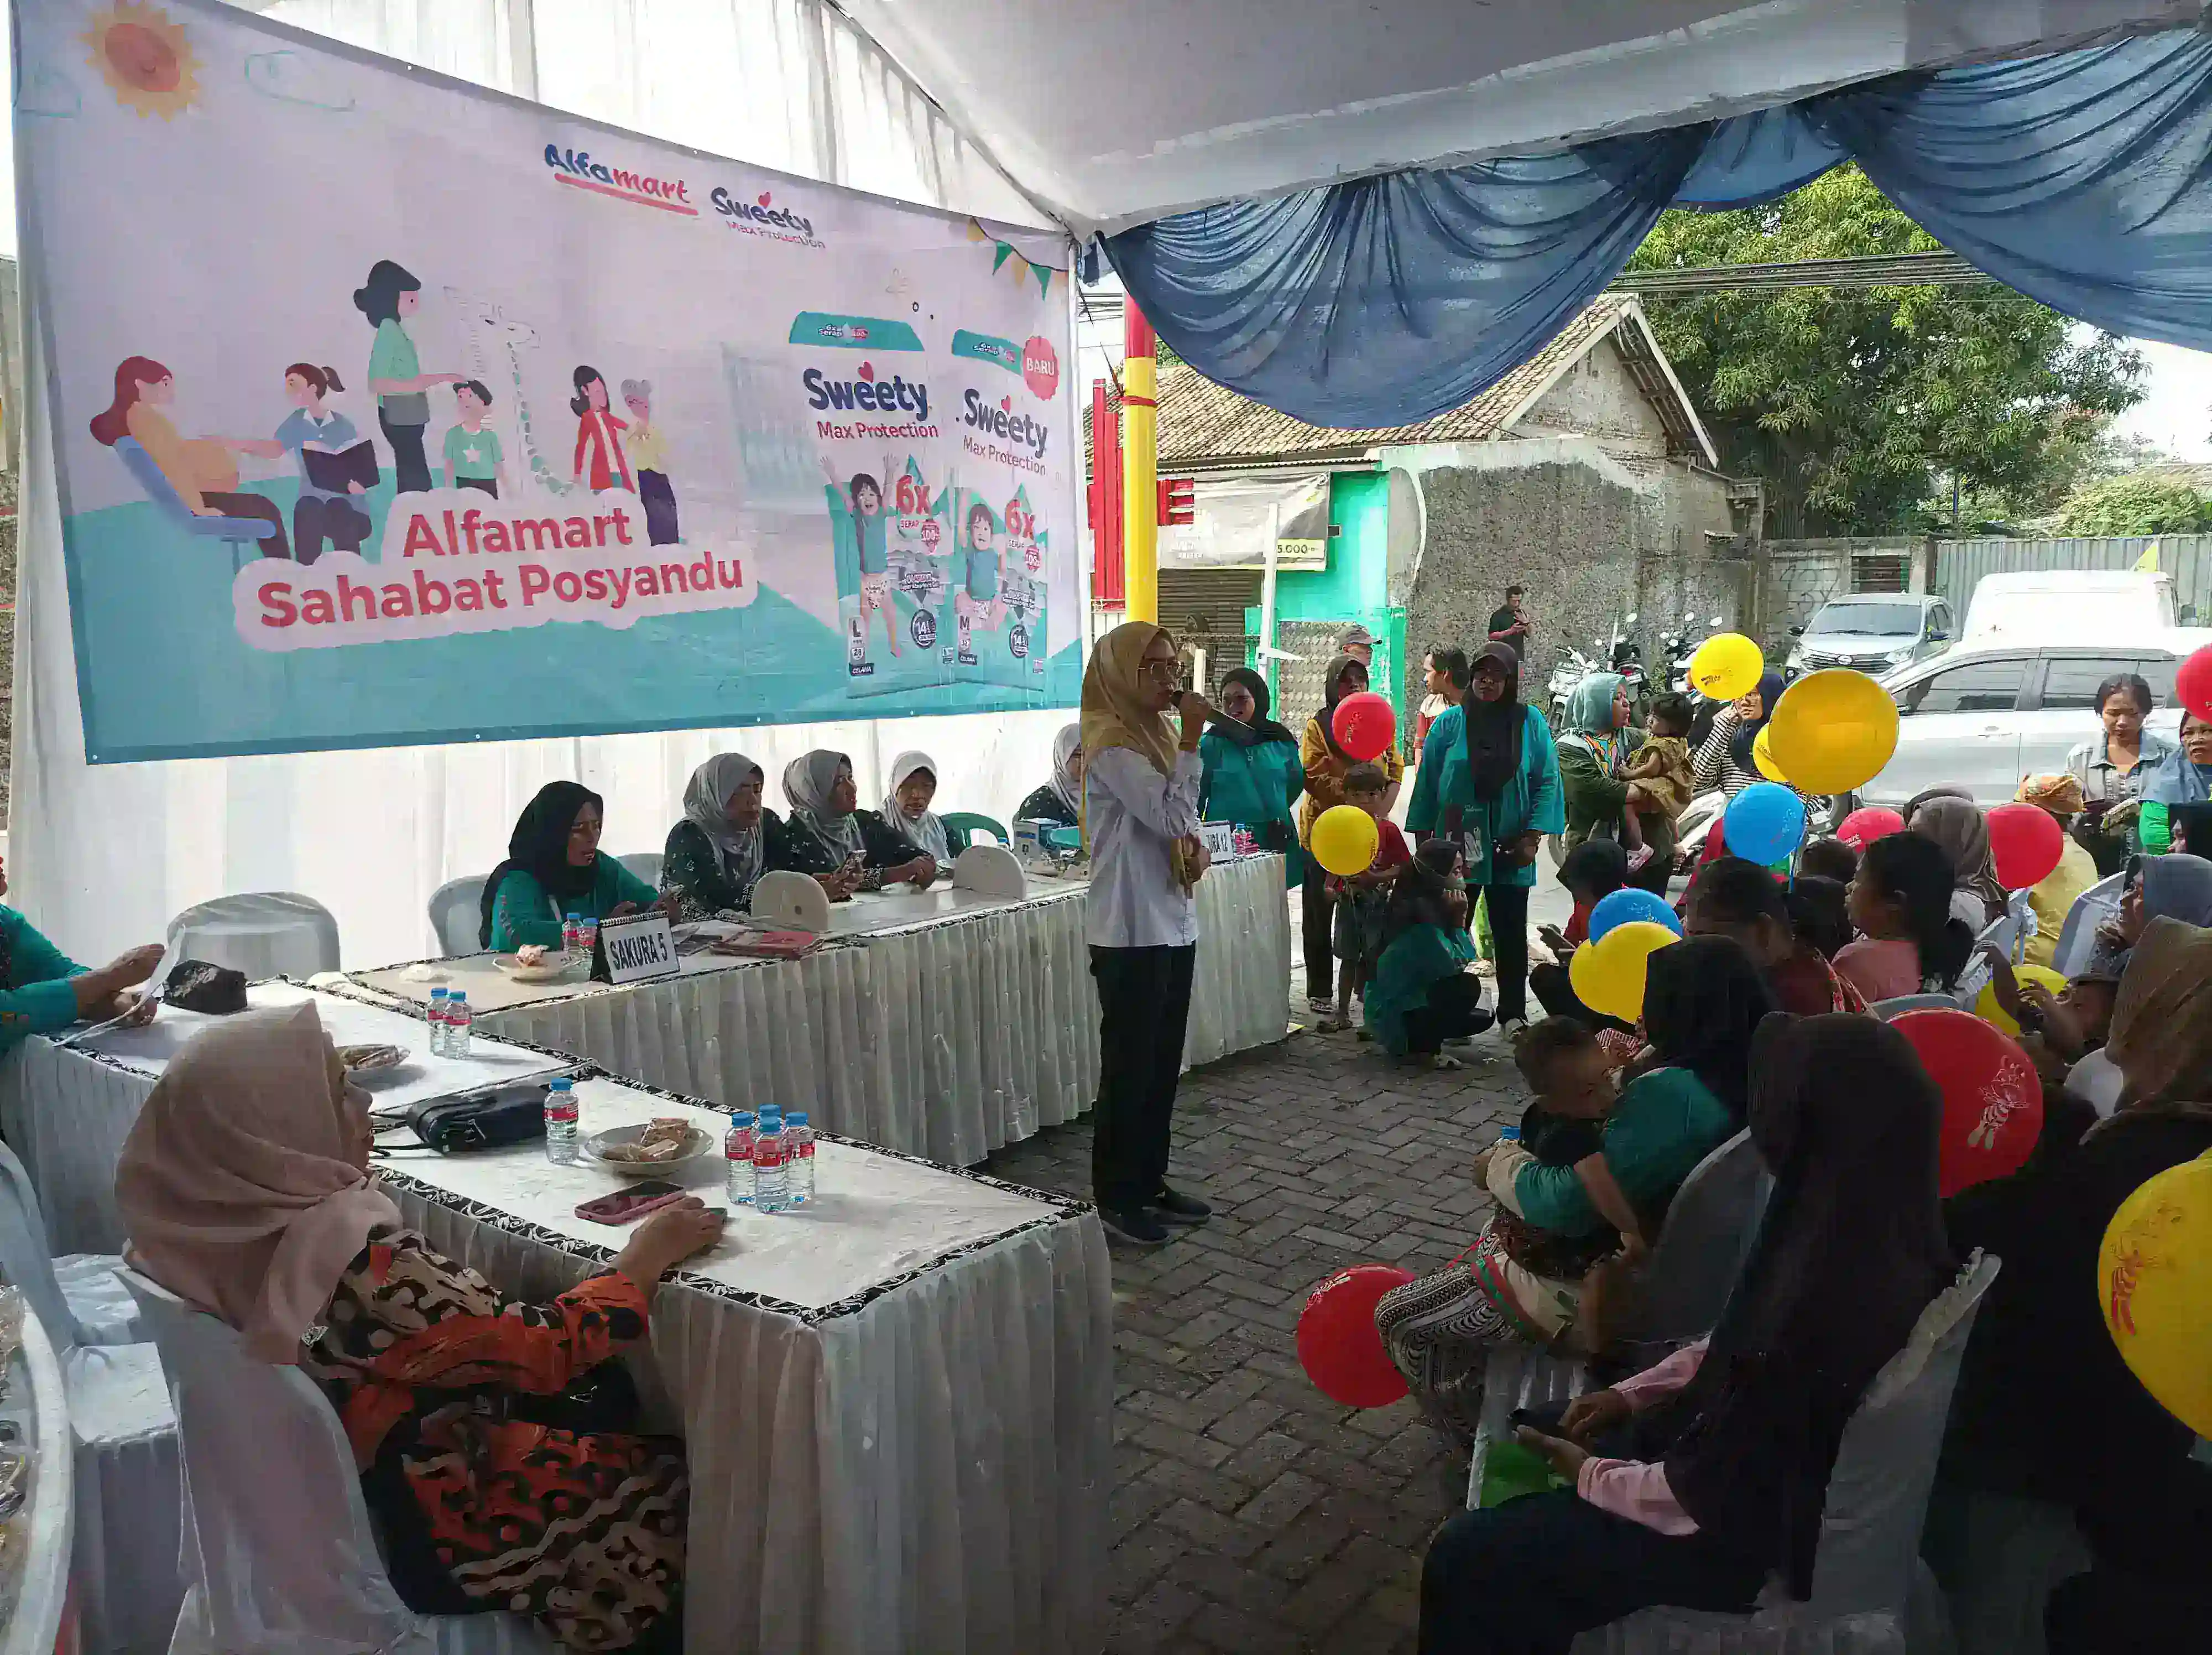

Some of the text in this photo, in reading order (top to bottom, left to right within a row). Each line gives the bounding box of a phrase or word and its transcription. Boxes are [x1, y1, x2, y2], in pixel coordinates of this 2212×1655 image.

[544, 144, 690, 203] Alfamart
[710, 187, 815, 237] Sweety
[726, 220, 826, 249] Max Protection
[1026, 357, 1055, 375] BARU
[803, 367, 928, 421] Sweety
[817, 421, 938, 440] Max Protection
[964, 388, 1048, 459] Sweety
[963, 435, 1046, 476] Max Protection
[896, 474, 931, 515] 6x
[403, 507, 633, 558] Alfamart
[1005, 499, 1036, 540] 6x
[257, 551, 744, 628] Sahabat Posyandu
[852, 619, 862, 637] L
[959, 615, 970, 630] M
[609, 933, 667, 970] SAKURA 5
